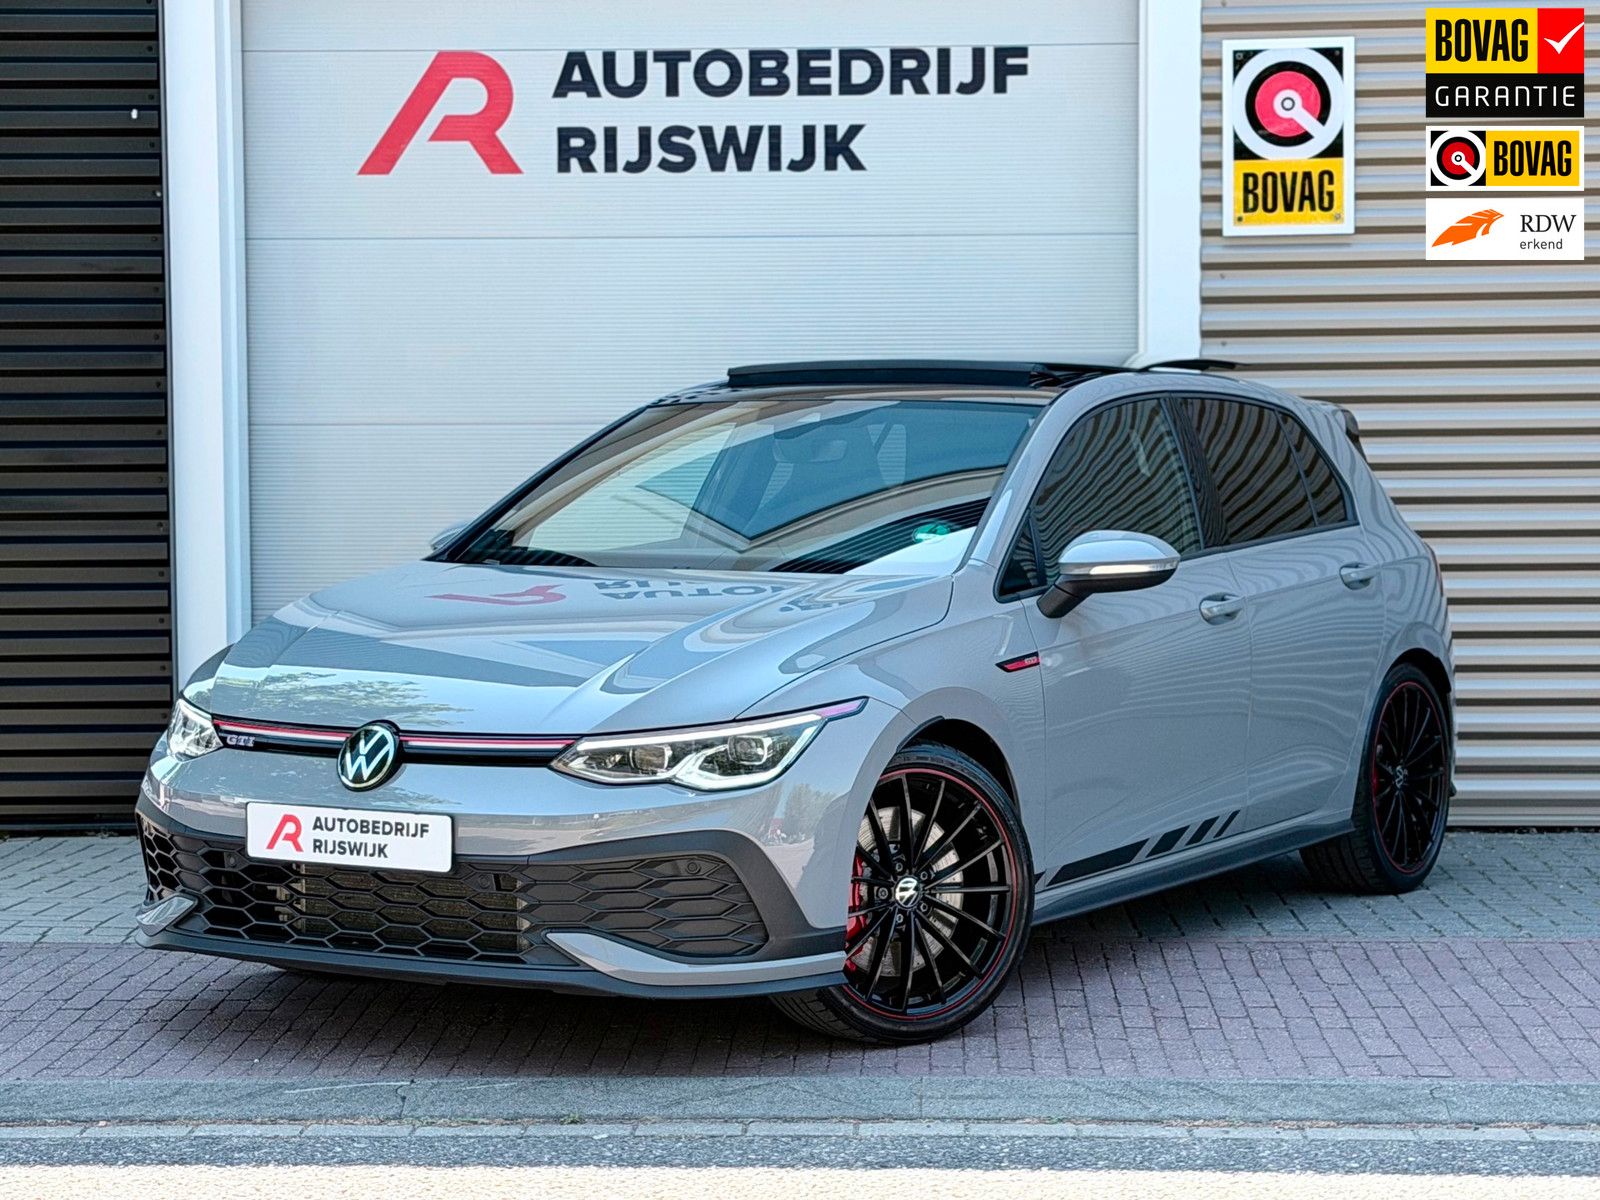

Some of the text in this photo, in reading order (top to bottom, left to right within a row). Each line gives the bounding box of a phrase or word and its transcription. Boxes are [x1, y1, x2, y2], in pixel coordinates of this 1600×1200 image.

[552, 46, 1029, 99] AUTOBEDRIJF
[557, 124, 866, 174] RIJSWIJK
[1242, 169, 1334, 214] BOVAG
[226, 734, 256, 747] GTI
[312, 816, 430, 839] AUTOBEDRIJF
[312, 838, 389, 859] RIJSWIJK
